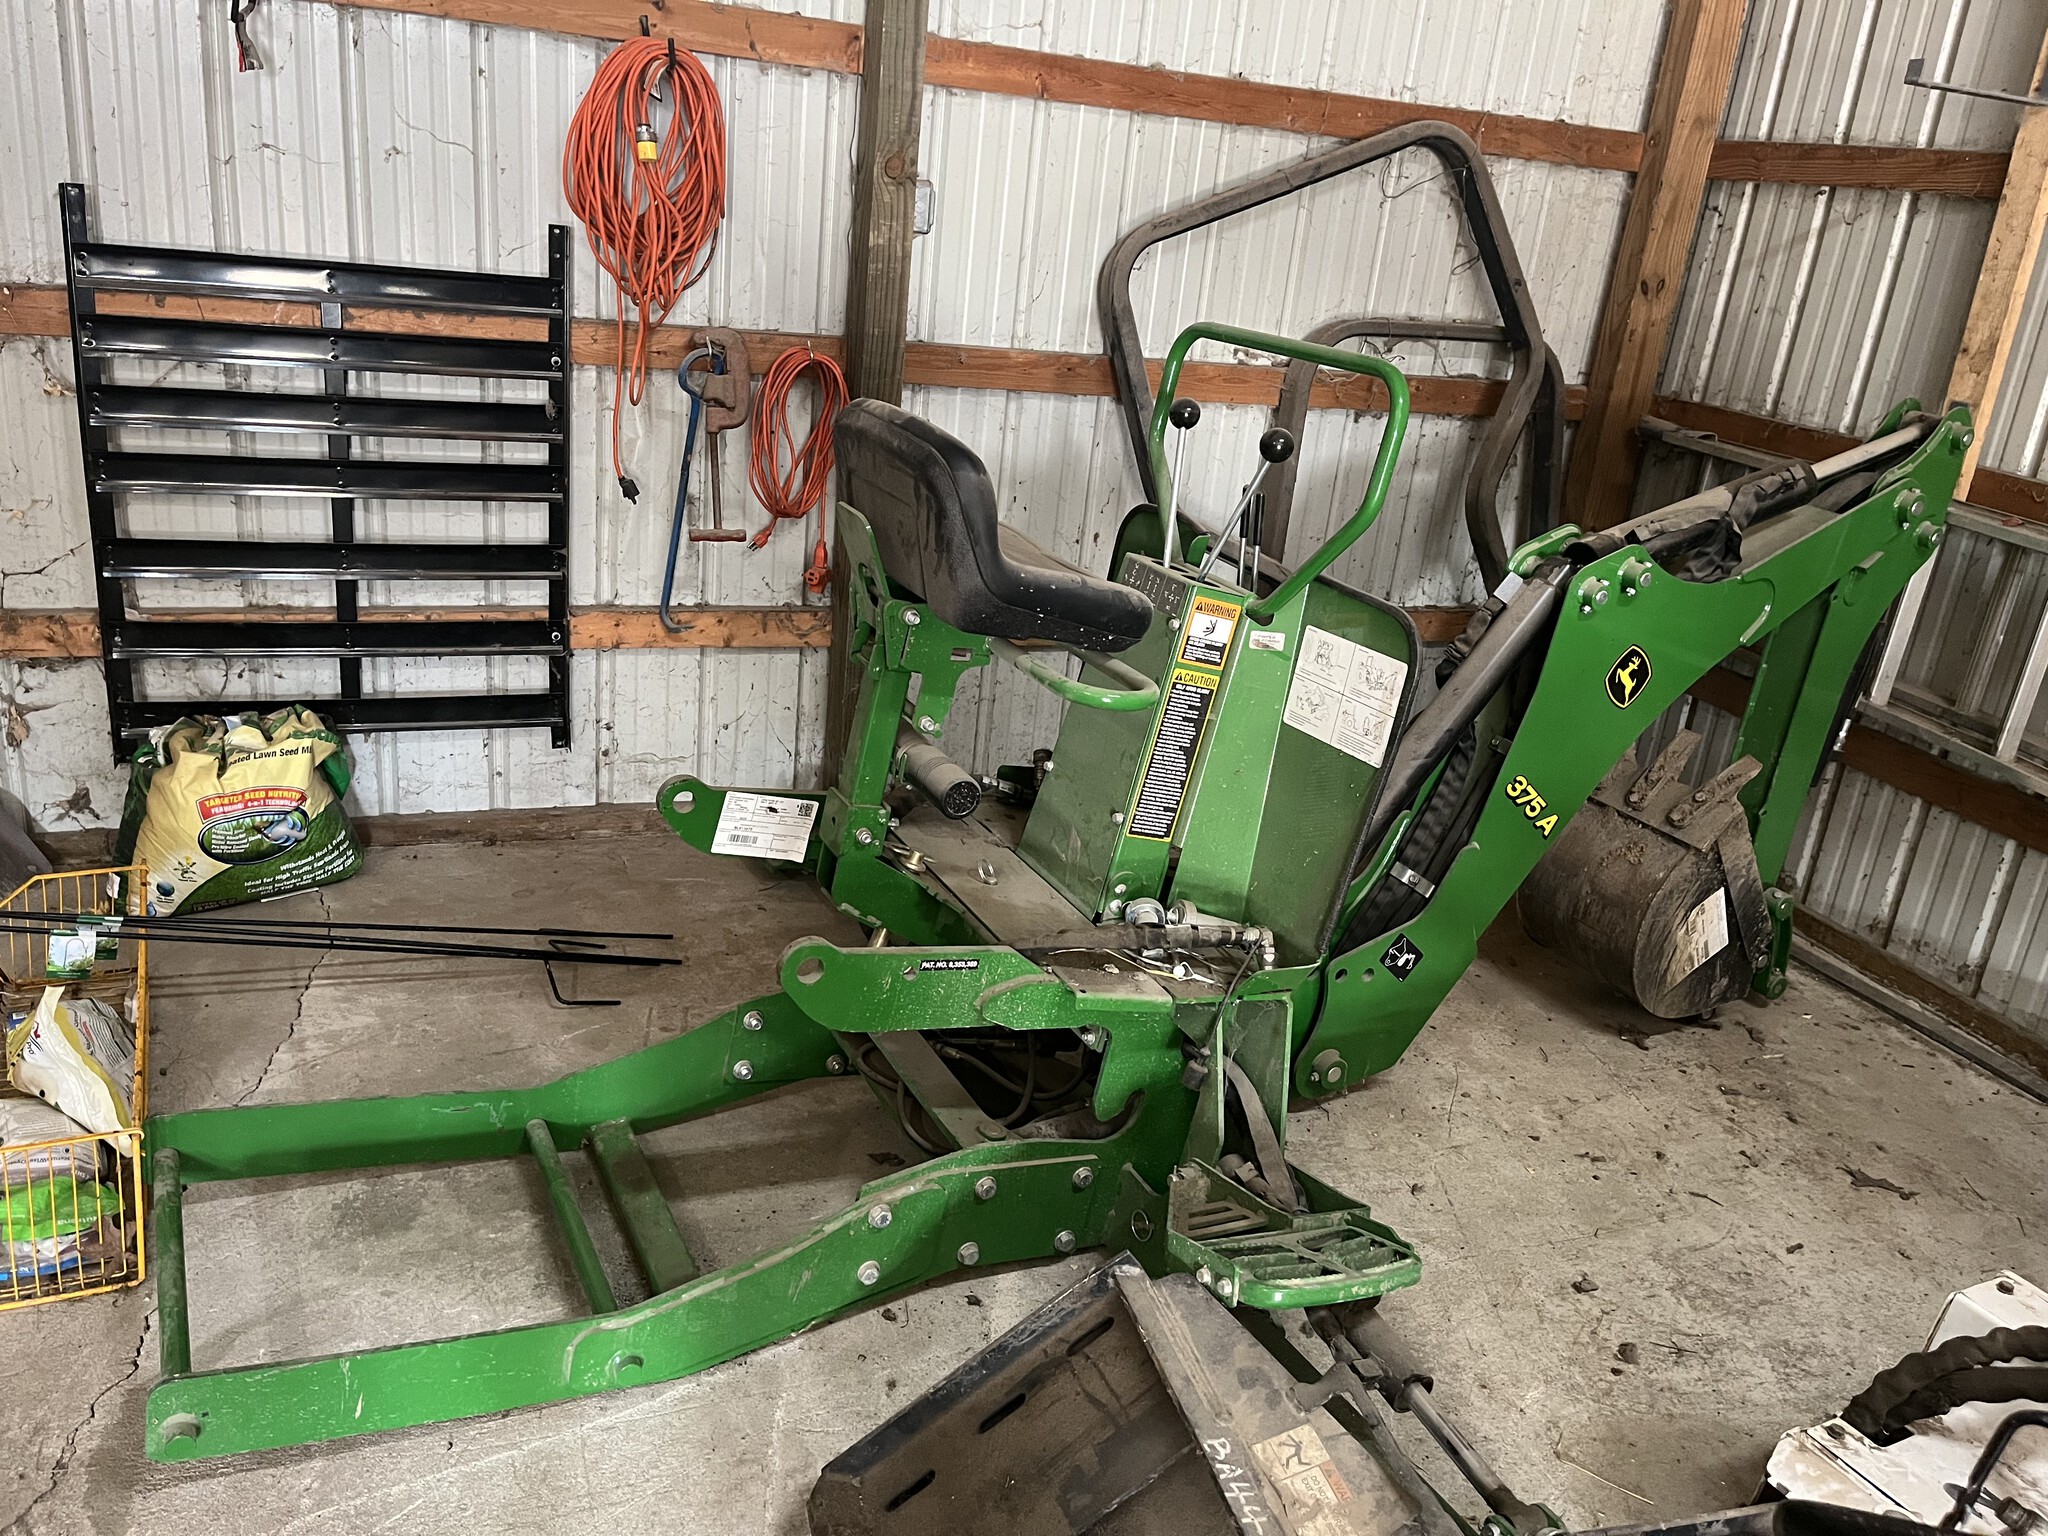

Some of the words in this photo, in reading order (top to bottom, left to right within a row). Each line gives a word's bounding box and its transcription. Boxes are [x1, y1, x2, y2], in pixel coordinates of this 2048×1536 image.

[1204, 602, 1237, 619] WARNING
[1183, 673, 1218, 688] CAUTION
[253, 751, 277, 760] Lawn
[279, 747, 299, 757] Seed
[204, 795, 243, 808] TARGETED
[244, 791, 266, 800] SEED
[244, 879, 262, 887] Ideal
[263, 876, 274, 884] for
[275, 872, 291, 881] High
[247, 884, 273, 894] Coating
